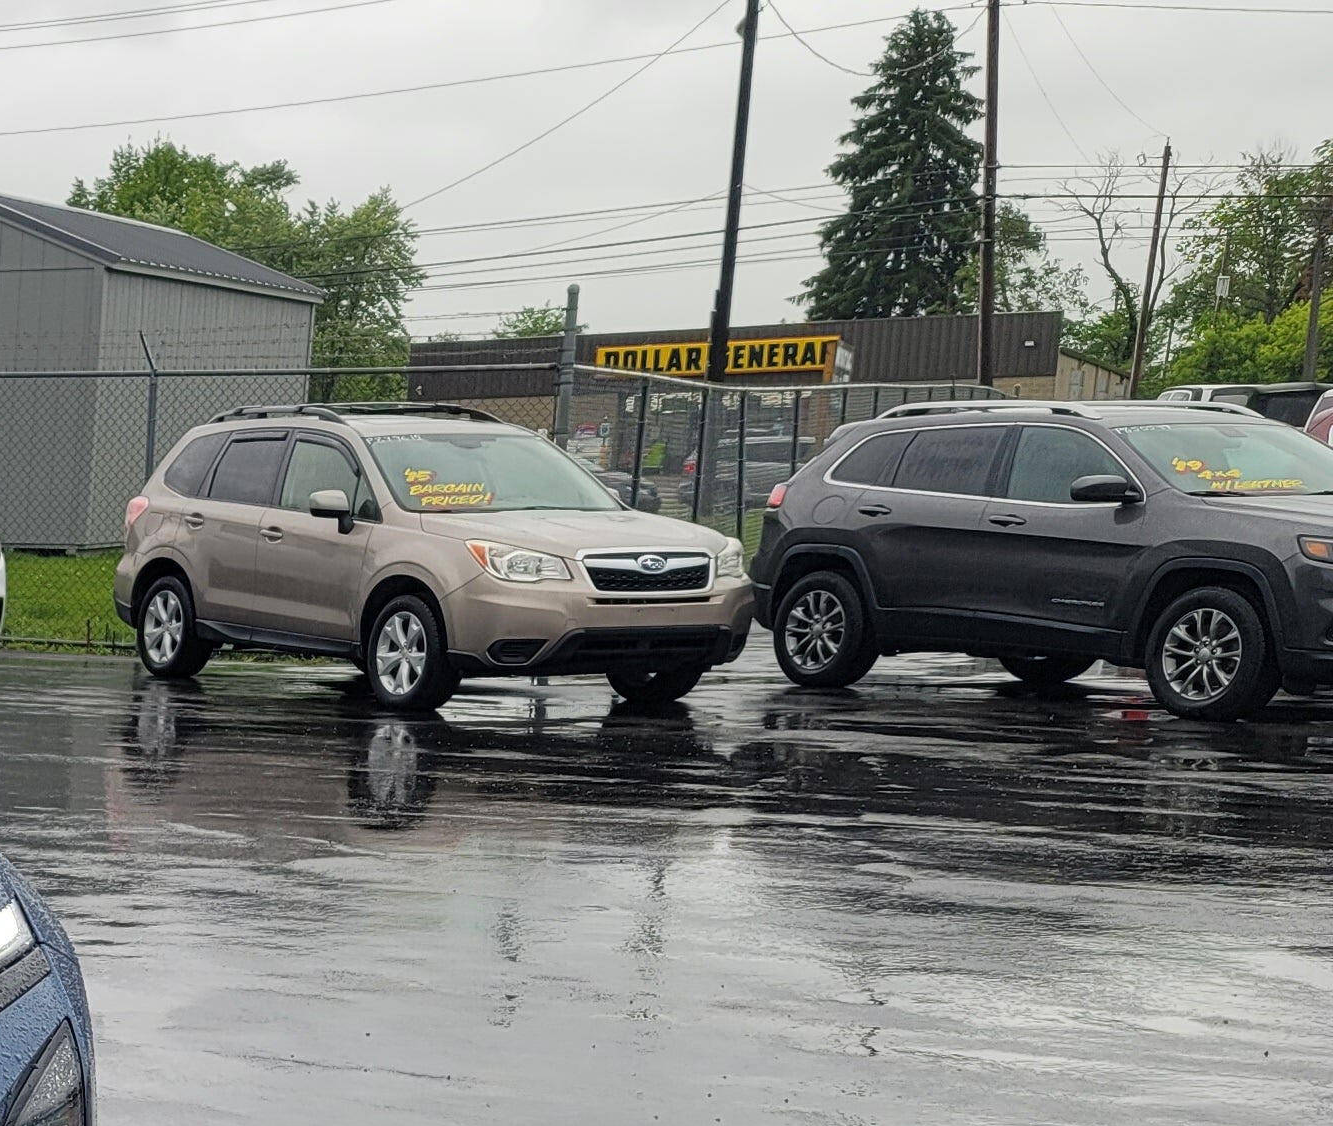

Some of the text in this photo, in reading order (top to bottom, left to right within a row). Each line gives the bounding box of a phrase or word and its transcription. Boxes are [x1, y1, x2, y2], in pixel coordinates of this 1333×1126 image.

[604, 340, 828, 372] DOLLAR ENERA
[409, 483, 485, 496] BARGAIN
[421, 492, 492, 506] PRICED!
